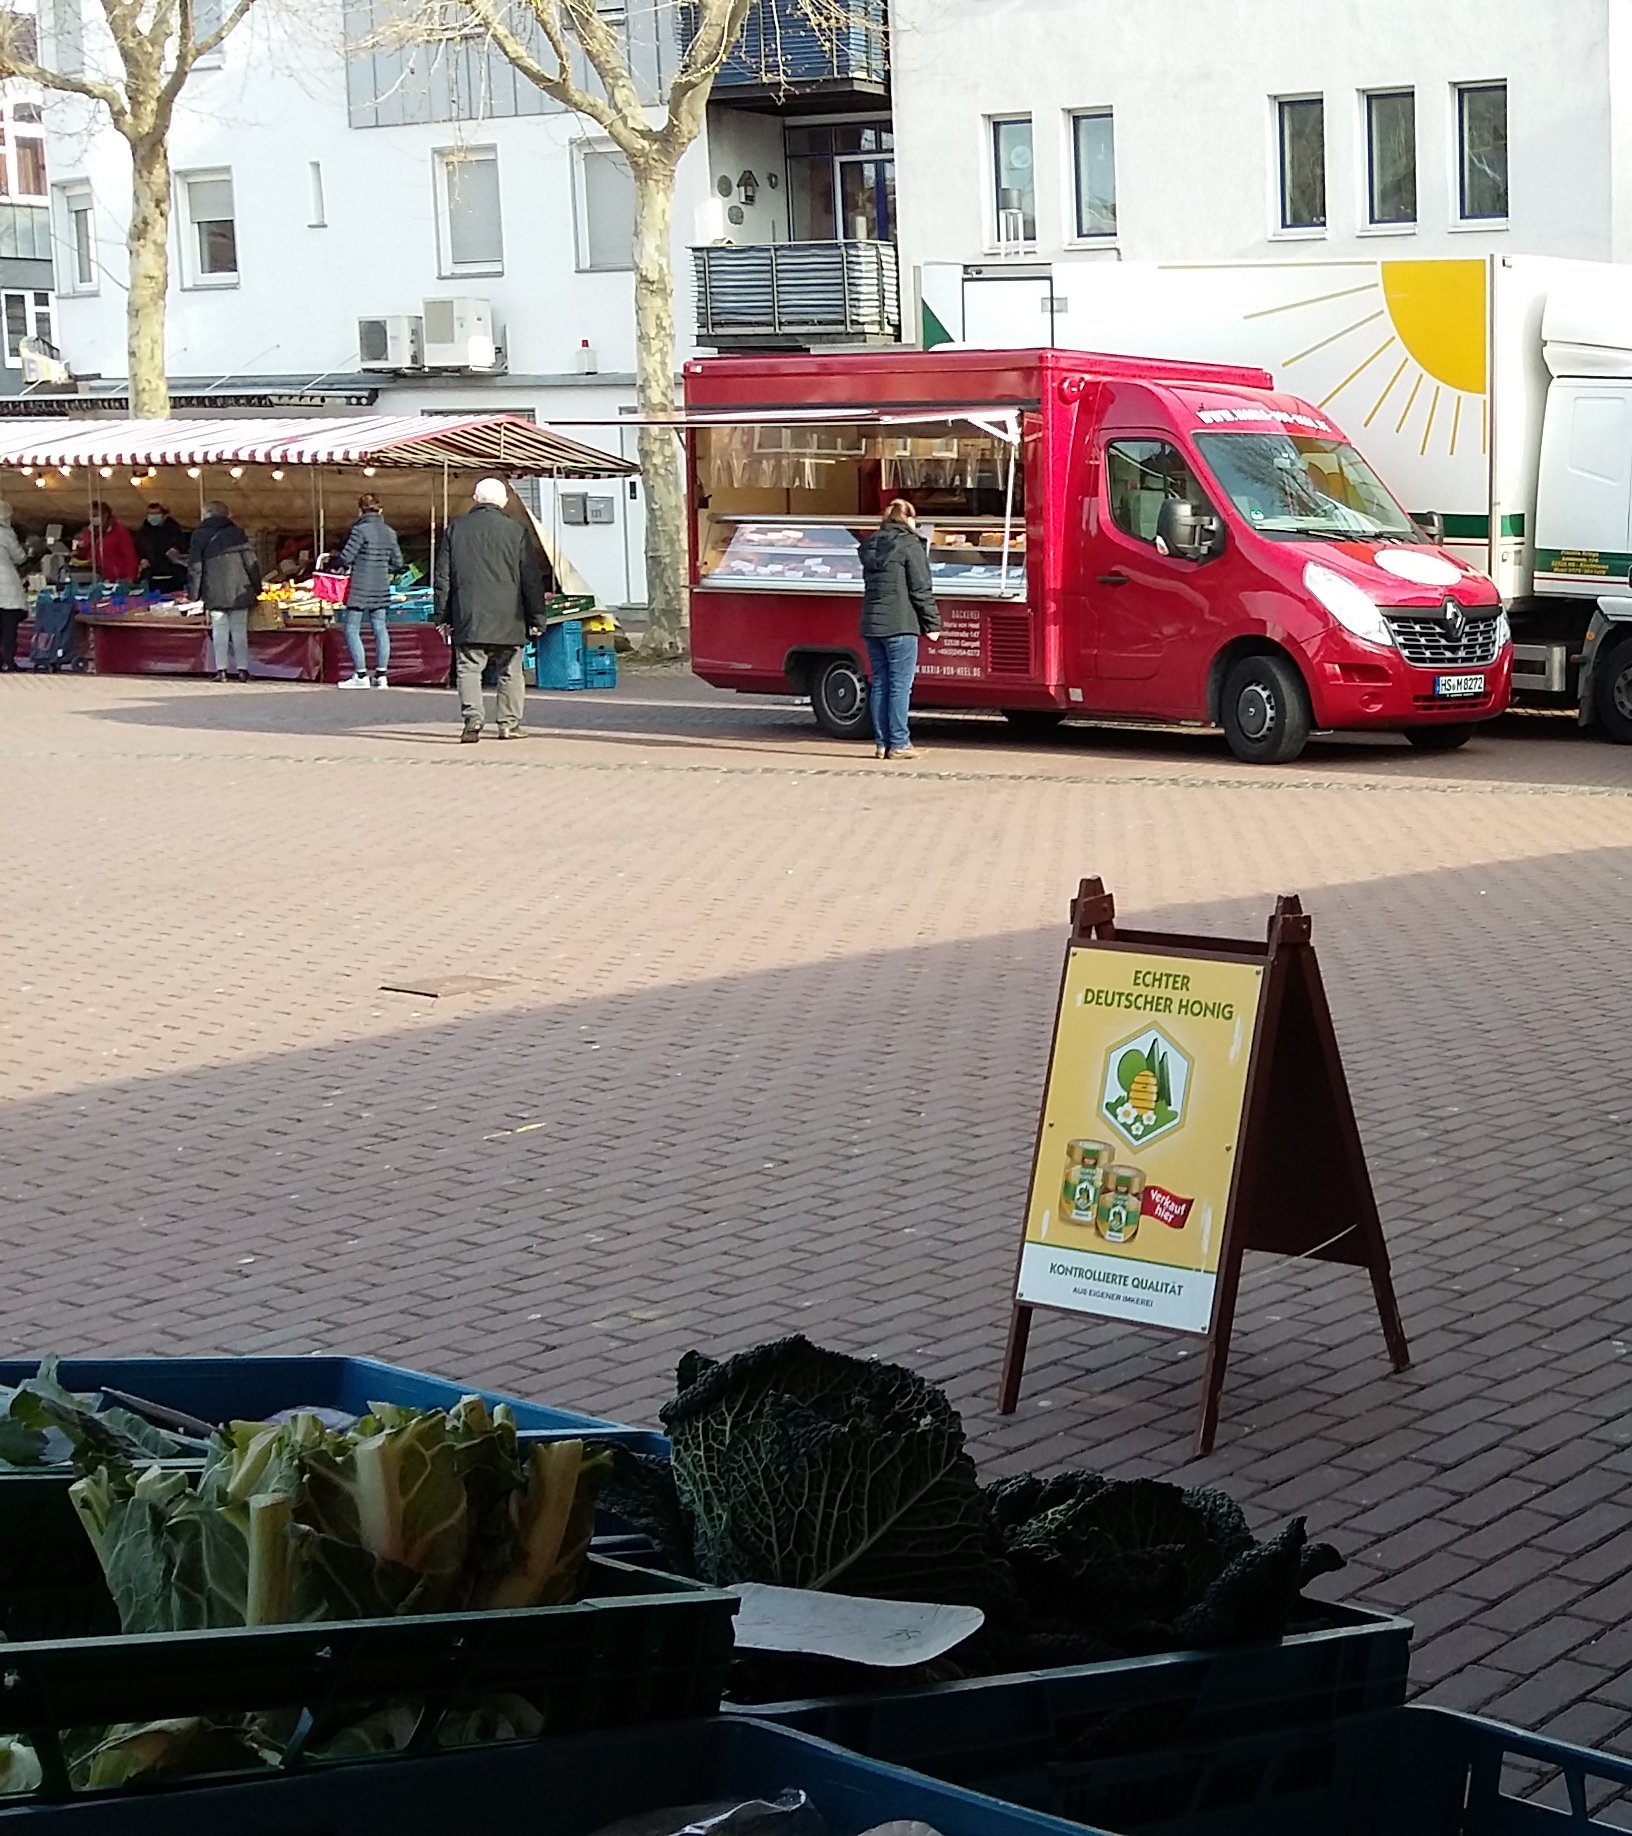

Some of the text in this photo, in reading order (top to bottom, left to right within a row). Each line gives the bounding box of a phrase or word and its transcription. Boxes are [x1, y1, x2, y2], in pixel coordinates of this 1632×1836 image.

[1132, 969, 1191, 992] ECHTER
[1083, 988, 1235, 1021] DEUTSCHER HONIG
[1149, 1188, 1188, 1216] Verkauf
[1154, 1204, 1176, 1223] hier
[1049, 1262, 1185, 1297] KONTROLLIERTE QUALITÄT
[1072, 1286, 1154, 1307] AUS EIGENER IMKEREI
